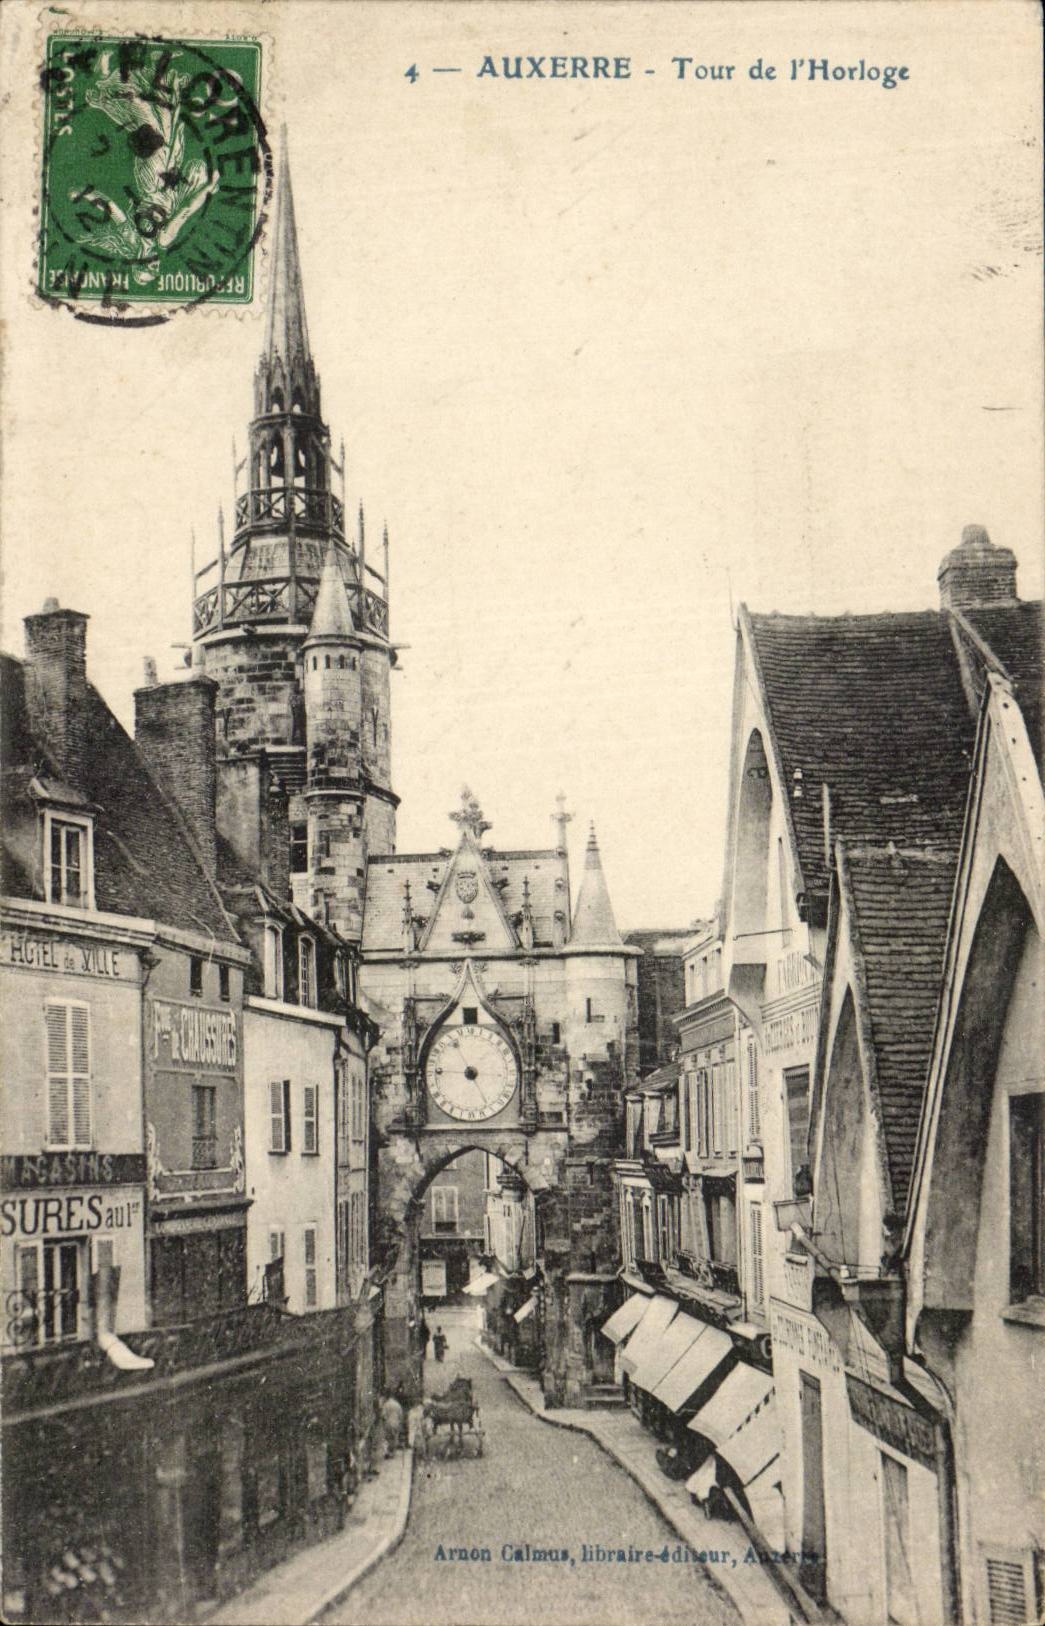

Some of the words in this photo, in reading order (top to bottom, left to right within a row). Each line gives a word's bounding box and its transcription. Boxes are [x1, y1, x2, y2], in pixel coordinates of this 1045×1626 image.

[65, 951, 75, 971] de
[82, 949, 120, 976] VILLE
[105, 1206, 124, 1229] au
